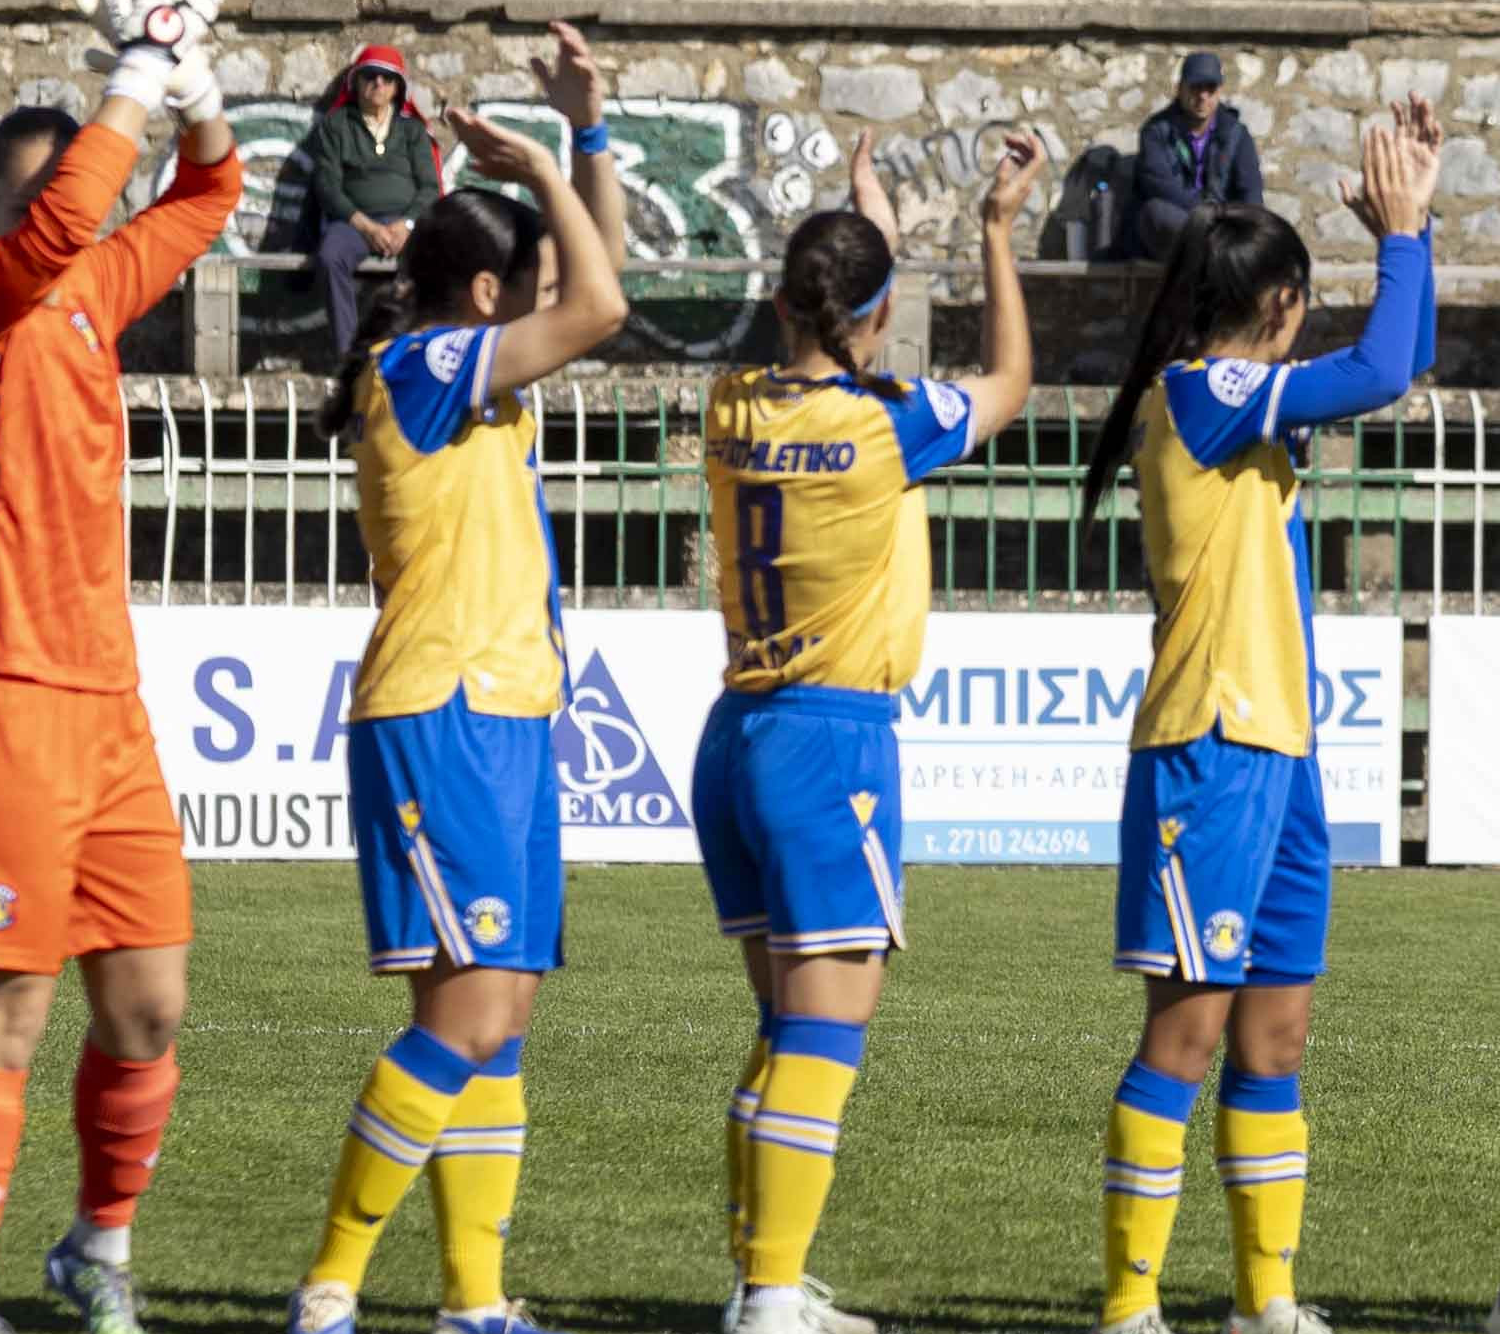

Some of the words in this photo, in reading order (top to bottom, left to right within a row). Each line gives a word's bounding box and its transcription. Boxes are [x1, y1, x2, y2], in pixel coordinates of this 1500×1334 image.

[176, 792, 356, 849] NDUST
[558, 789, 674, 827] EMO
[948, 829, 1000, 853] 2710
[1008, 829, 1090, 855] 242694
